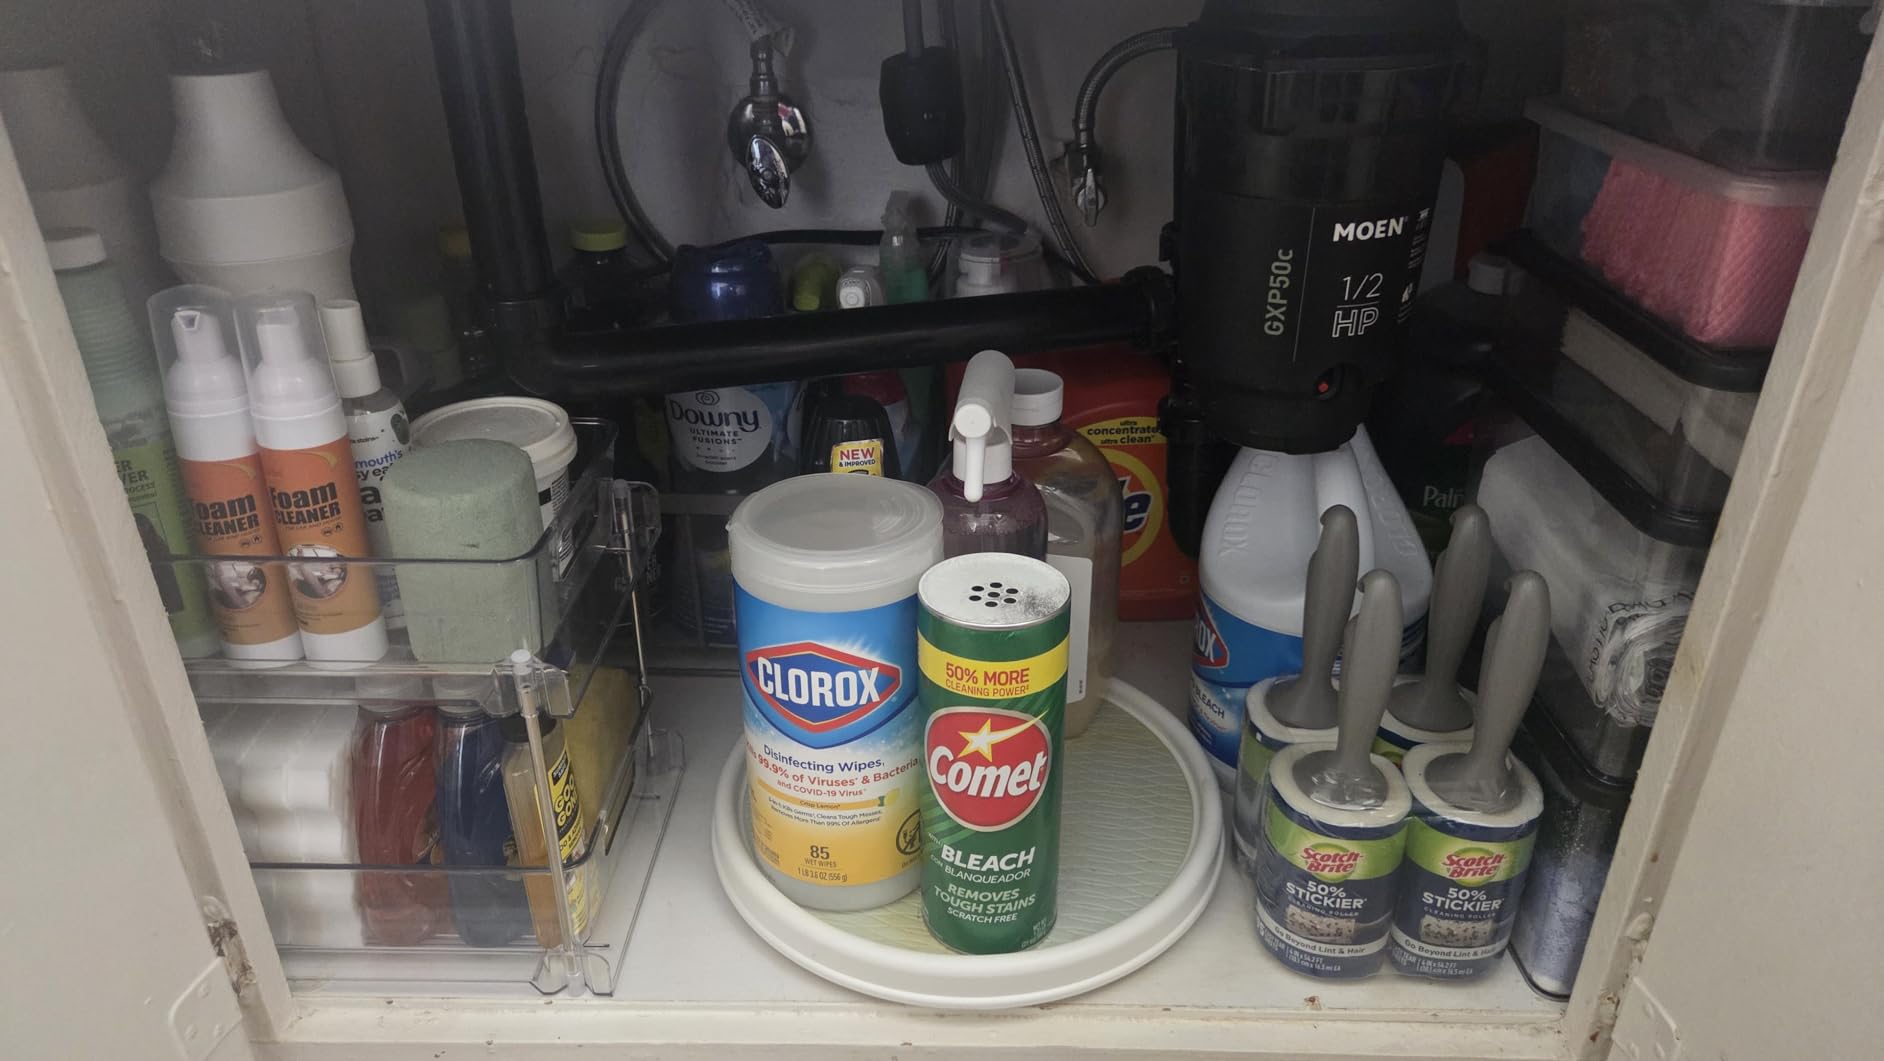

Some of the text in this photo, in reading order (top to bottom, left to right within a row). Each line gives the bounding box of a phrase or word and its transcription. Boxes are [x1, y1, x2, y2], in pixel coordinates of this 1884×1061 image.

[1332, 216, 1404, 242] MOEN
[1264, 249, 1293, 336] GXP50c
[1342, 273, 1383, 301] 1/2
[1332, 307, 1379, 338] HP
[671, 400, 760, 432] Downy
[689, 428, 739, 438] ULTIMATE
[1087, 426, 1160, 435] concentrate
[839, 447, 876, 461] NEW
[844, 459, 876, 467] IMPROVED
[194, 494, 257, 520] oam
[274, 502, 341, 526] CLEANER
[199, 513, 259, 536] LEANER
[757, 656, 880, 707] CLOROX
[945, 662, 1030, 686] 50% MORE
[945, 678, 990, 697] CLEANING
[758, 753, 789, 779] 99.9%
[792, 774, 804, 783] of
[861, 775, 870, 784] &
[873, 758, 919, 782] Bacteria
[763, 744, 834, 774] Disinfecting
[930, 745, 1047, 798] Comet
[777, 780, 791, 790] and
[793, 783, 837, 797] COVID-19
[804, 858, 837, 868] WET WIPES
[809, 845, 830, 860] 85
[941, 845, 1035, 872] BLEACH
[819, 872, 828, 881] OZ
[944, 865, 1031, 884] BLANQUEADOR
[934, 885, 1036, 914] TOUGH STAINS
[947, 883, 1020, 901] REMOVES
[1307, 881, 1346, 898] 50%
[1447, 887, 1487, 901] 50%
[947, 907, 1018, 924] SCRATCH FREE
[1285, 933, 1317, 951] Beyond
[1319, 946, 1336, 955] Lint
[1404, 938, 1416, 949] Go
[1418, 945, 1452, 957] Beyond
[1453, 950, 1470, 958] Lint
